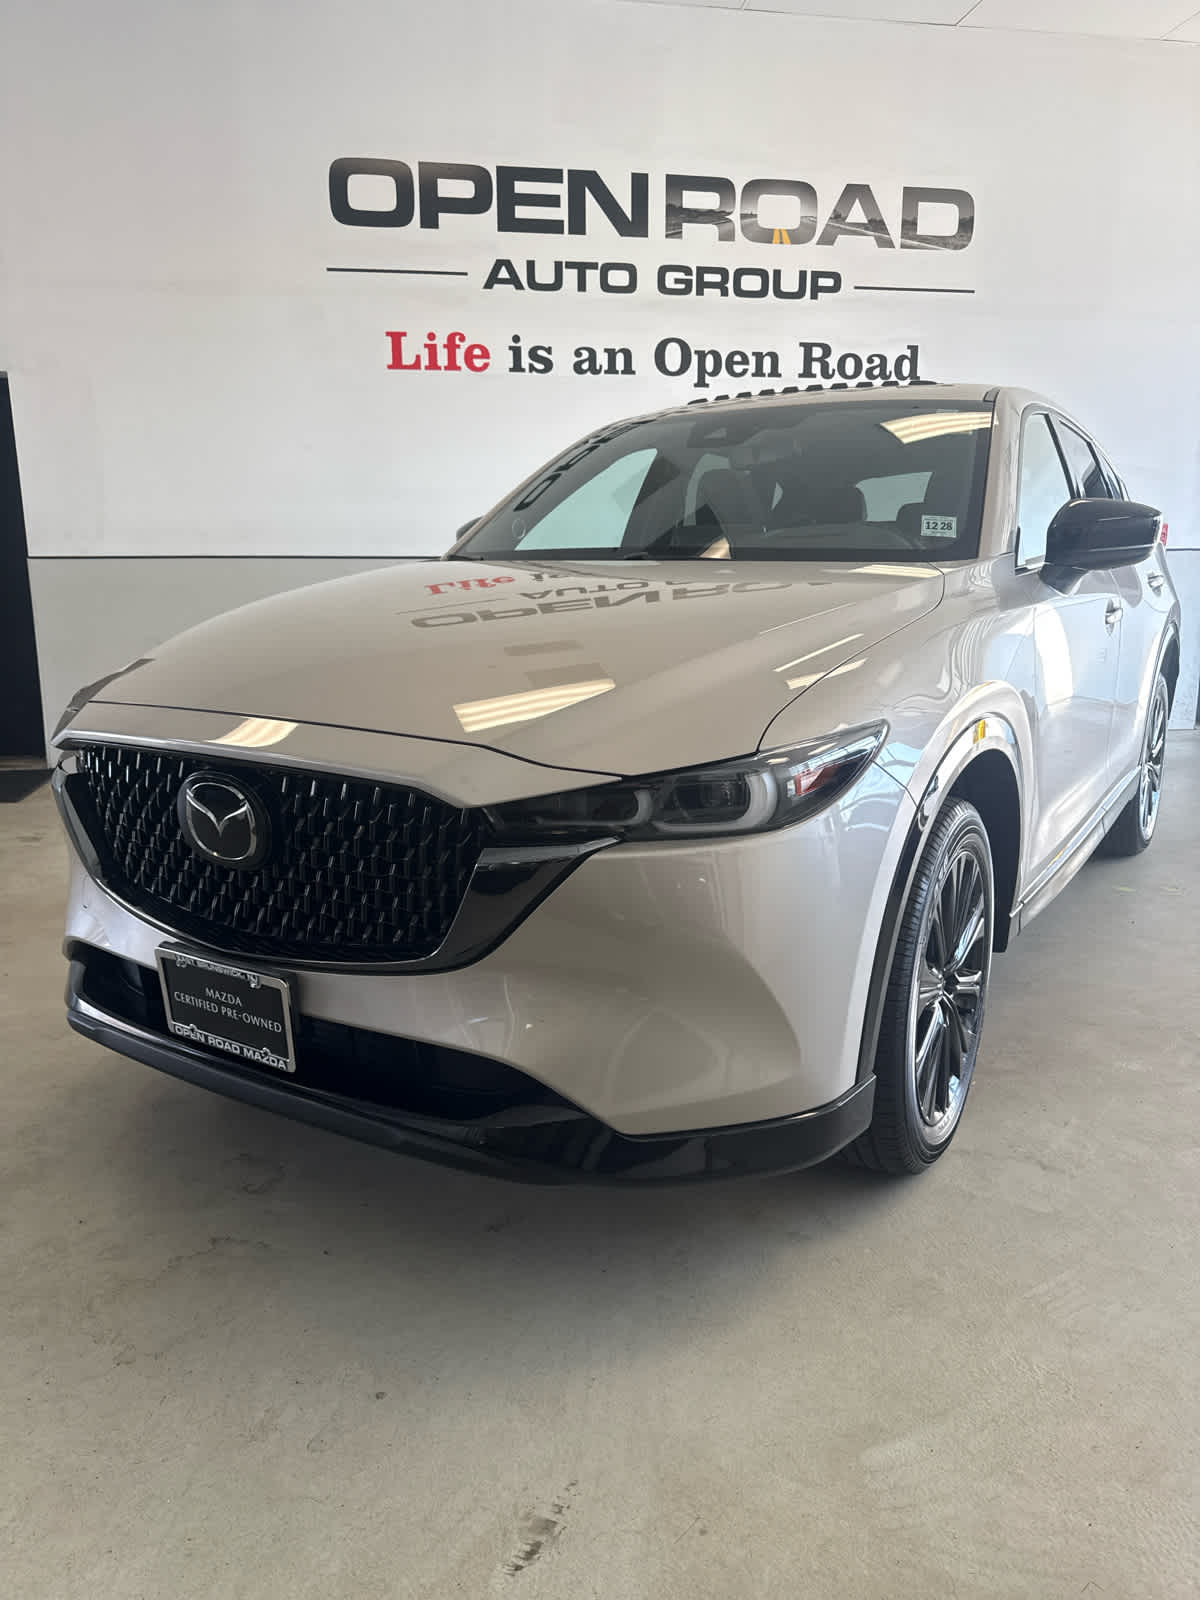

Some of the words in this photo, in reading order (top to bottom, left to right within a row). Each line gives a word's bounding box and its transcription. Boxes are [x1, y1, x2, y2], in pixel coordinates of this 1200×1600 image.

[328, 157, 649, 238] OPEN
[664, 173, 975, 251] ROAD
[483, 258, 638, 294] AUTO
[656, 264, 842, 301] GROUP
[385, 331, 491, 373] Life
[508, 334, 554, 375] is
[572, 346, 636, 376] an
[654, 337, 782, 388] Open
[798, 341, 921, 381] Road
[925, 521, 938, 530] 12
[940, 521, 953, 530] 28
[174, 991, 219, 1013] CERTIFIED
[221, 1006, 282, 1033] PRE-OWNED
[205, 987, 242, 1007] MAZDA
[175, 1025, 205, 1043] OPEN
[208, 1036, 240, 1054] ROAD
[243, 1047, 287, 1070] MAZDA
